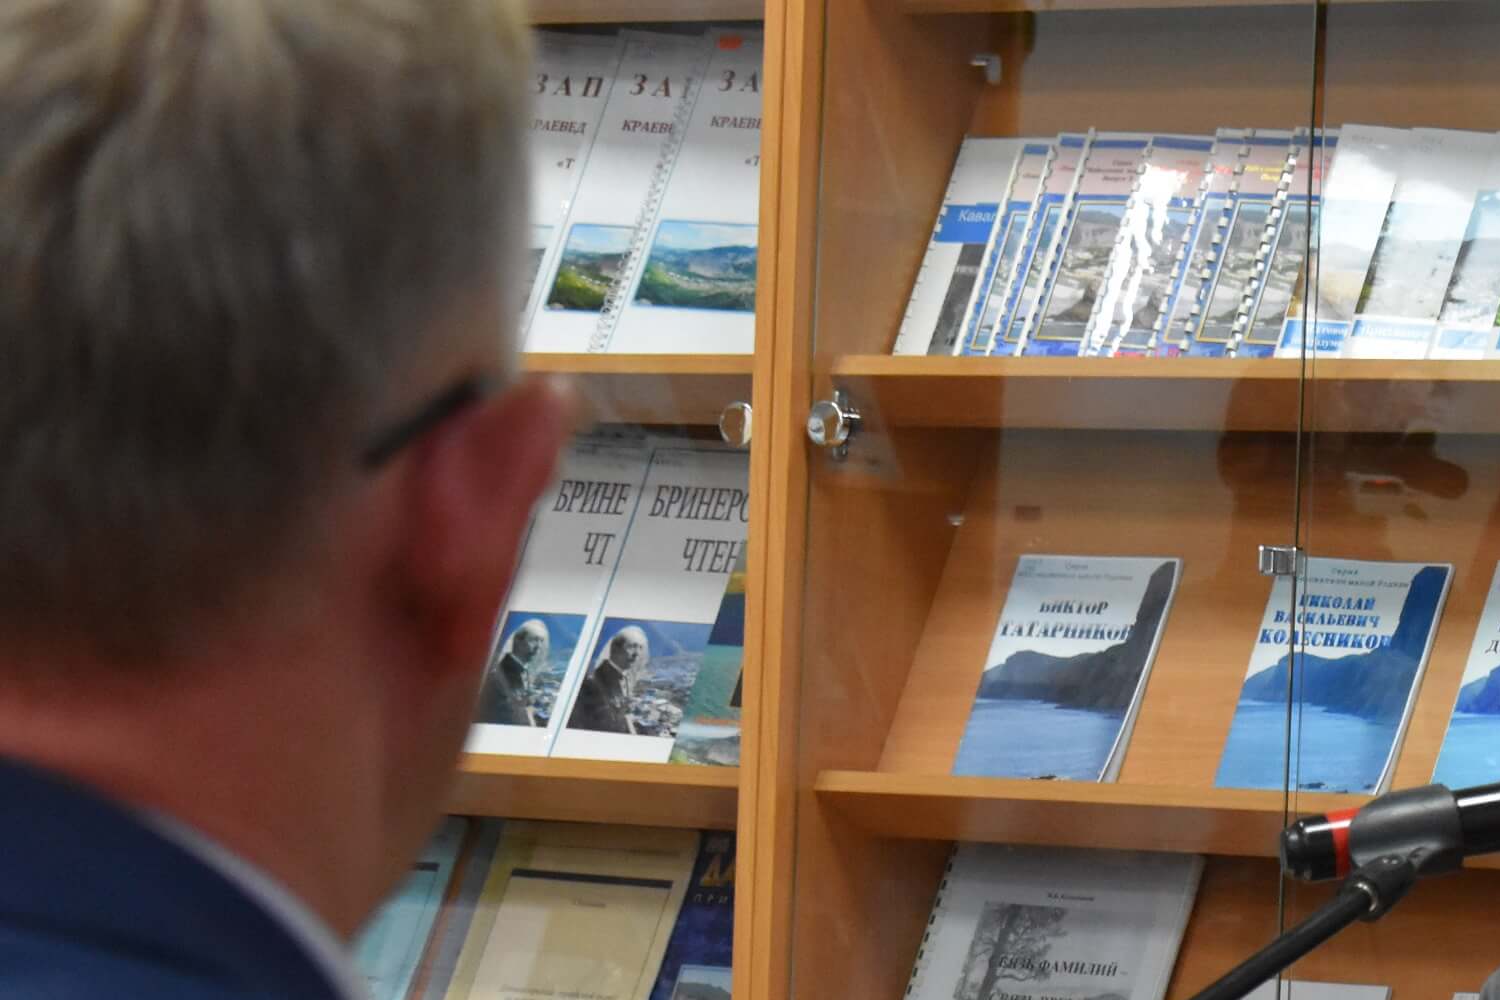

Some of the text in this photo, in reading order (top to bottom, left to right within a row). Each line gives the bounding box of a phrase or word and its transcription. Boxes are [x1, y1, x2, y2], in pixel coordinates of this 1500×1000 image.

[552, 480, 631, 515] БРИНЕ
[583, 532, 616, 565] ЧТ
[1039, 960, 1118, 977] ФАМИЛИЙ
